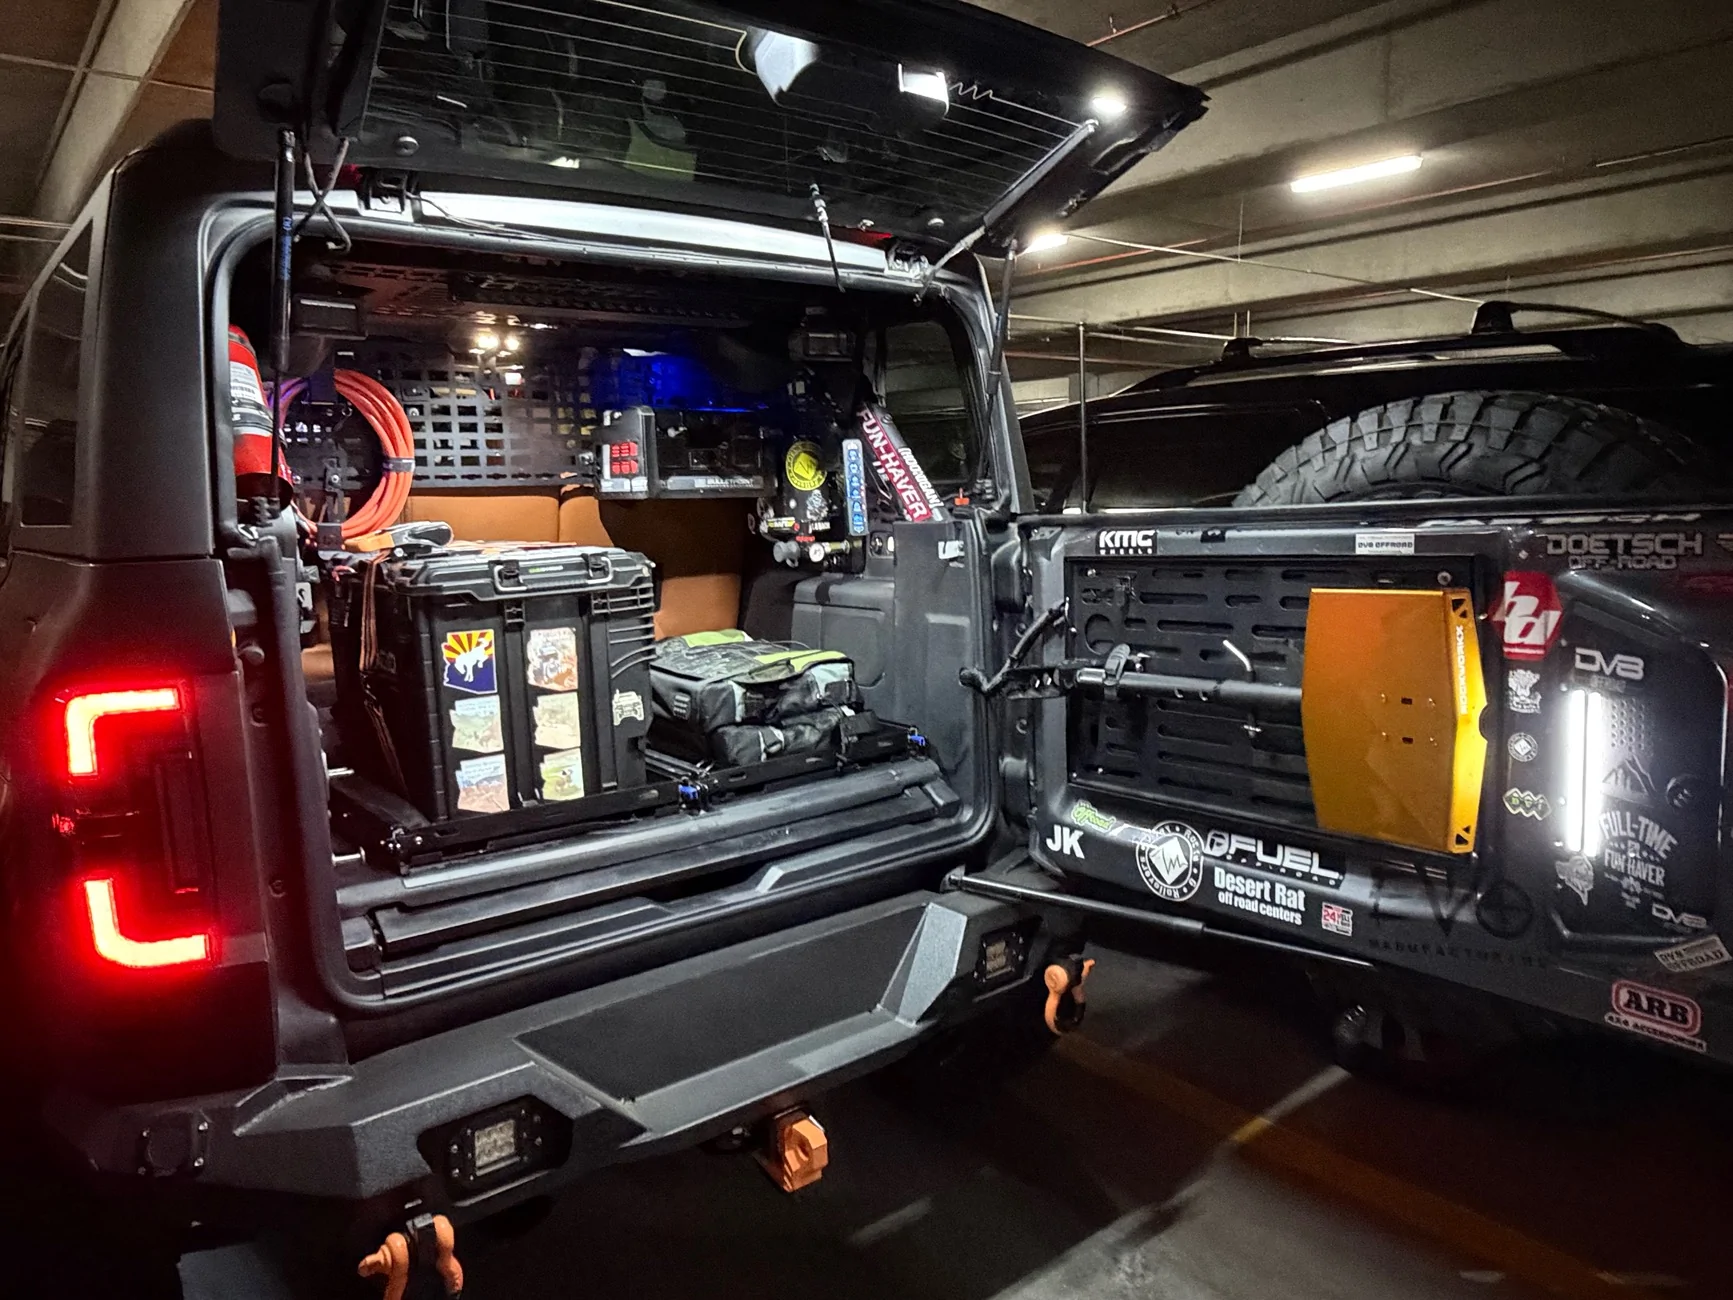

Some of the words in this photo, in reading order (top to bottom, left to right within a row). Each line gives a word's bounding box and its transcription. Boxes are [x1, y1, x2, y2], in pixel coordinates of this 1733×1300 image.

[856, 410, 927, 521] FUN-HAVER
[1099, 530, 1156, 548] KMC
[1547, 533, 1703, 555] DOETSCH
[1575, 647, 1645, 680] DV8
[1046, 825, 1085, 859] JK
[1599, 810, 1678, 859] FULL-TIME
[1229, 834, 1340, 879] FUEL
[1628, 859, 1665, 887] HAVER
[1214, 866, 1271, 902] Desert
[1274, 882, 1306, 911] Rat
[1218, 891, 1234, 906] off
[1234, 894, 1258, 913] road
[1259, 903, 1302, 926] centers
[1652, 903, 1707, 928] DV8
[1622, 989, 1689, 1025] ARB
